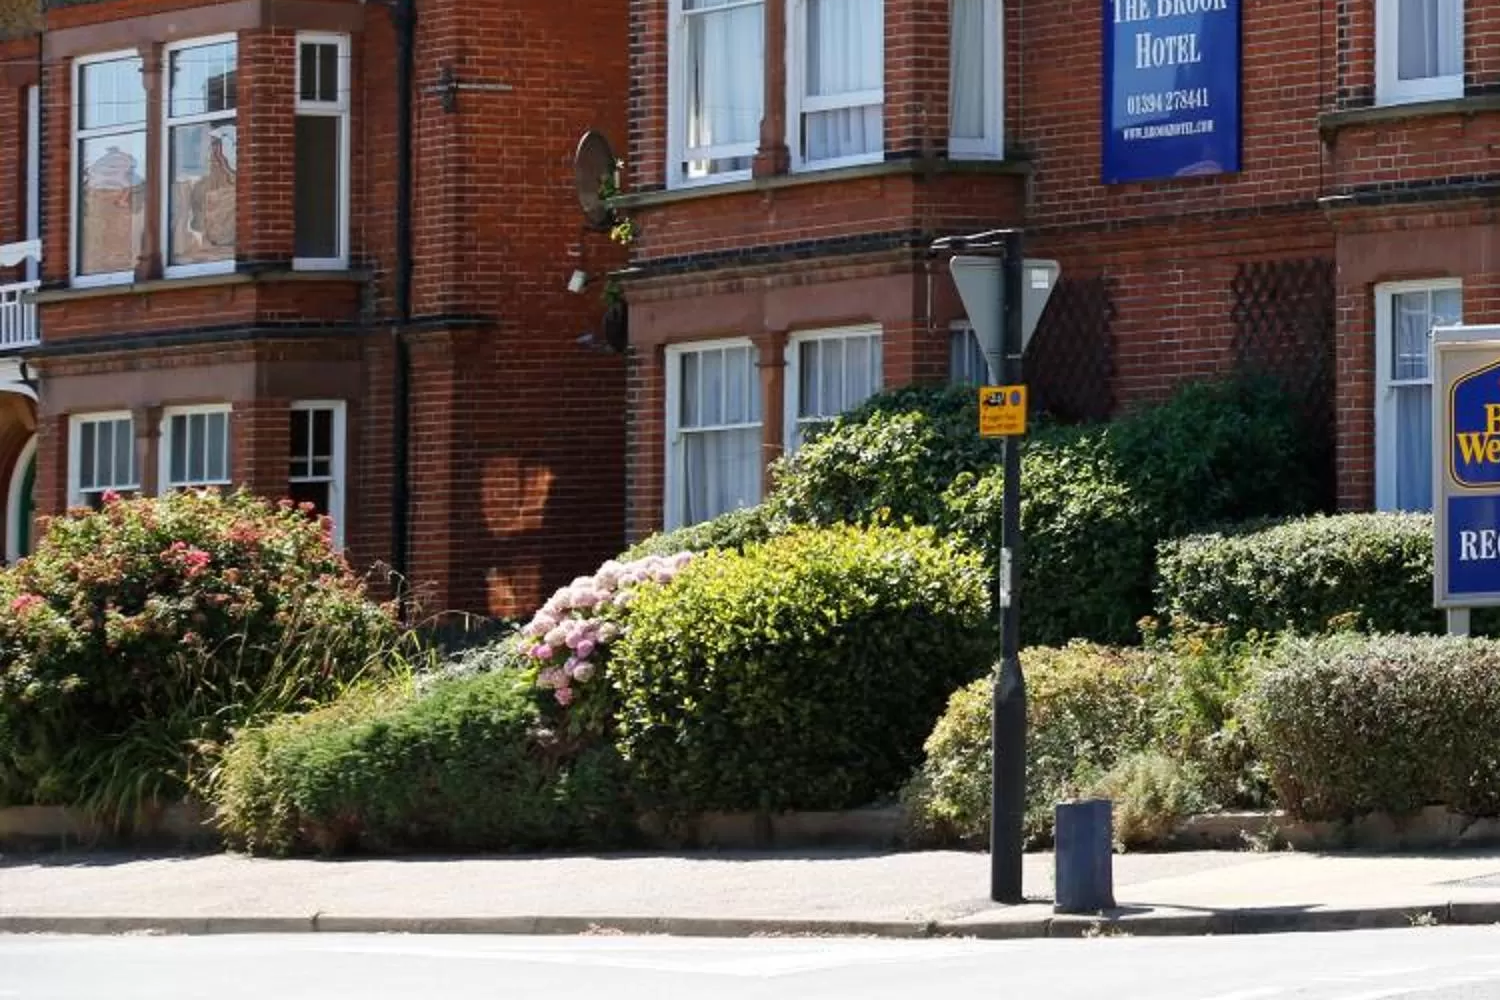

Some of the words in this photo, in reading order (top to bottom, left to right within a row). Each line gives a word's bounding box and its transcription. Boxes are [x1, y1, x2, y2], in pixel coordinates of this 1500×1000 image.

[1135, 32, 1201, 69] HOTEL
[1127, 93, 1163, 115] 01394
[1165, 88, 1209, 111] 278441
